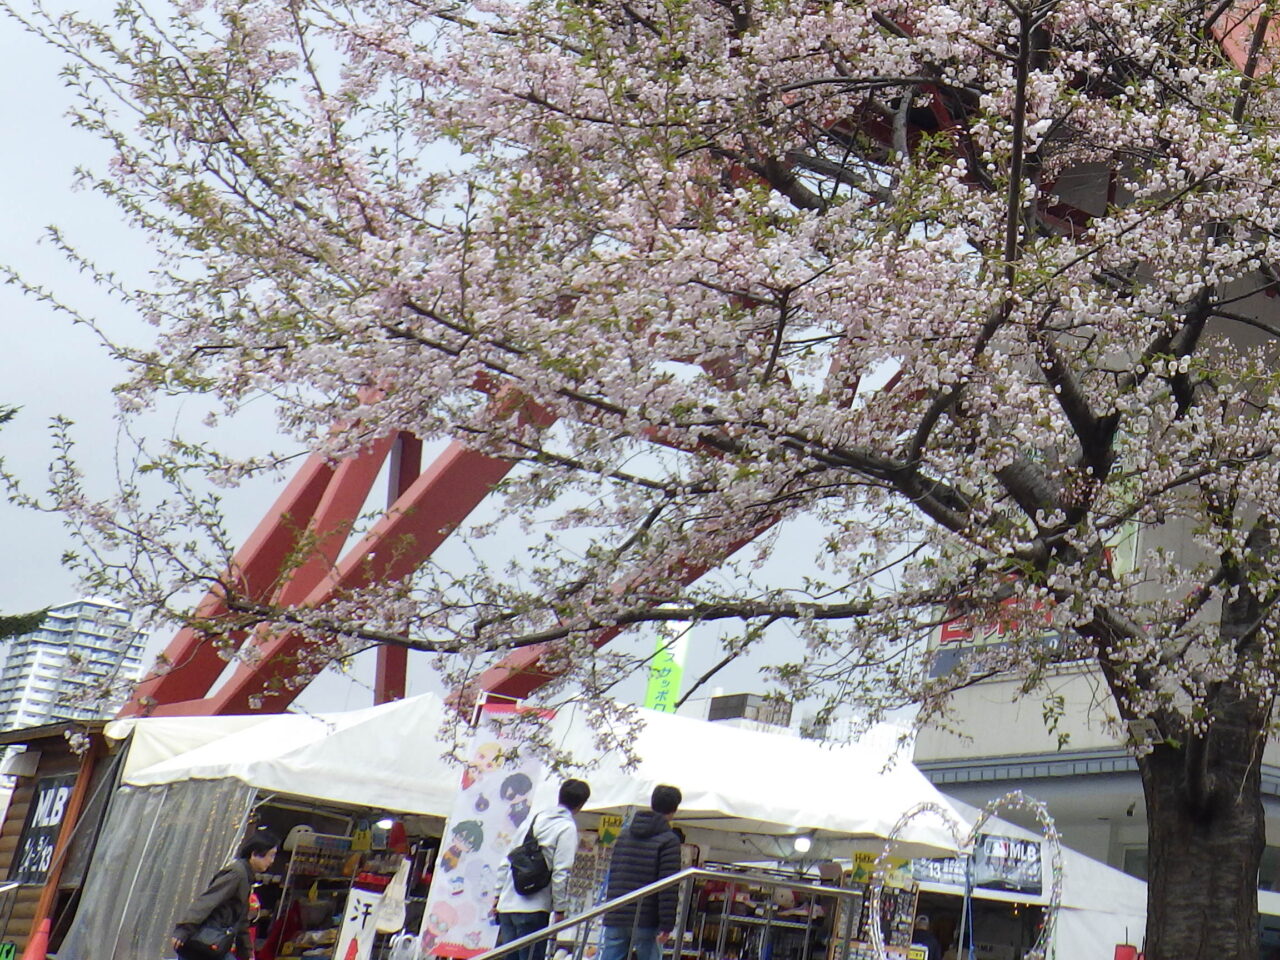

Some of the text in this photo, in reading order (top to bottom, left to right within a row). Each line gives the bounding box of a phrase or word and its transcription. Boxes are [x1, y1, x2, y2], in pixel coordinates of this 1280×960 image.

[31, 787, 69, 828] MLB
[1010, 843, 1037, 861] MLB
[350, 898, 373, 930] 汗
